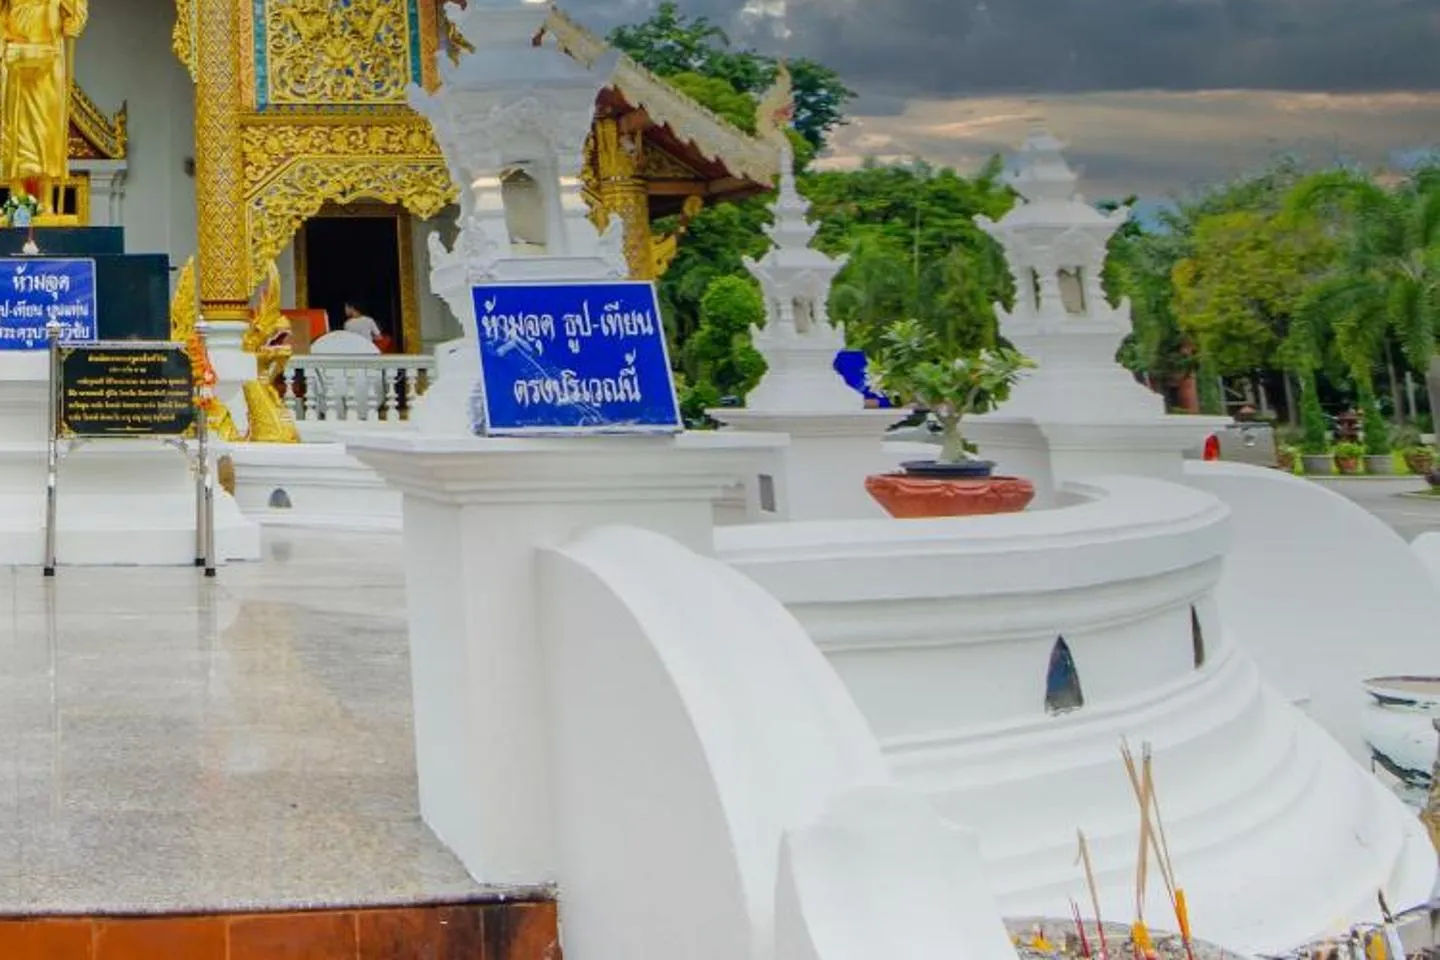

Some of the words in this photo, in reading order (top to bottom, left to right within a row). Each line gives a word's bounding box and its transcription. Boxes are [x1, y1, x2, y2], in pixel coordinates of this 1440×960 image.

[13, 263, 70, 301] ห้ามจุด
[481, 295, 555, 355] ห้ามจุด
[563, 300, 654, 353] ธูป-เทียน
[514, 349, 642, 407] ตรงบริเวณนี้
